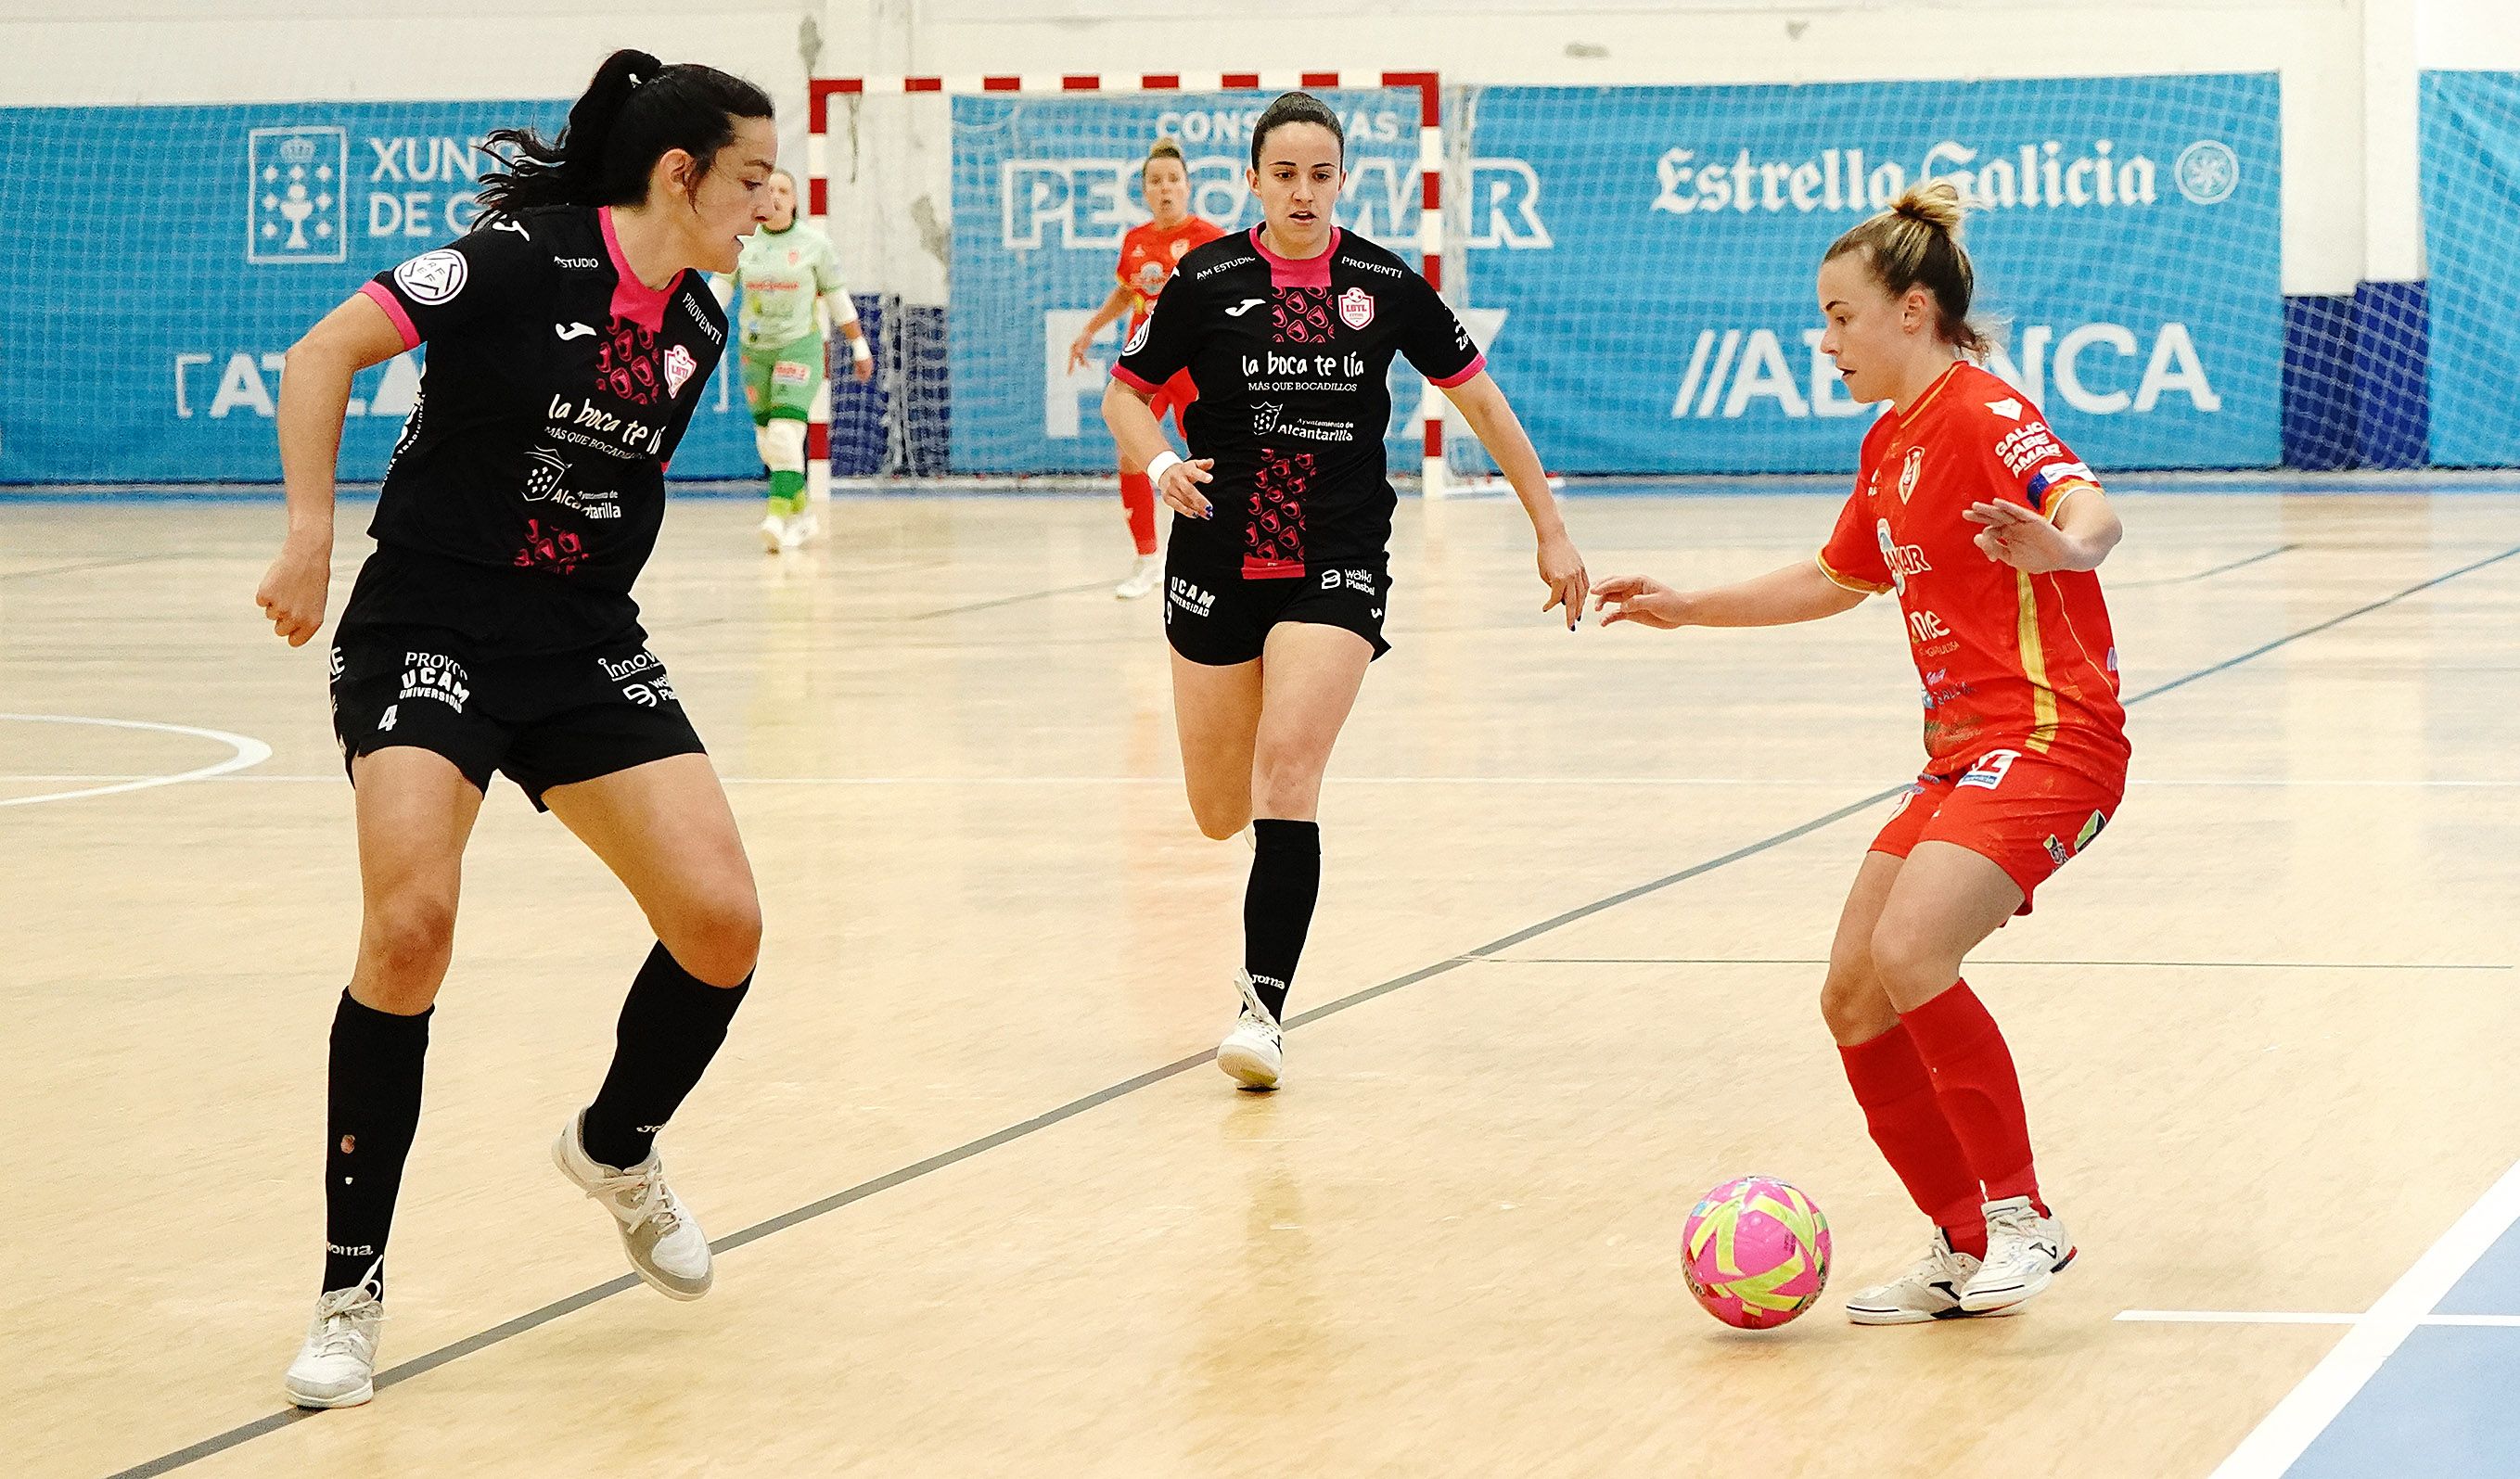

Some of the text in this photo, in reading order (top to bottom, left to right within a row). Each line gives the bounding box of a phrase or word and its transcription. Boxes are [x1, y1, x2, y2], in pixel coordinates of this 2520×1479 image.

[367, 135, 521, 184] XUNT
[1651, 147, 1907, 214] Estrella
[368, 190, 433, 238] DE
[1341, 256, 1402, 279] PROVENTI
[682, 292, 723, 345] PROVENTI
[1242, 355, 1260, 377] la
[1267, 351, 1308, 376] boca
[1314, 354, 1337, 376] te
[1272, 381, 1294, 391] QUE
[1295, 381, 1358, 391] BOCADILLOS
[548, 393, 572, 419] la
[573, 398, 621, 432] boca
[621, 420, 648, 445] te
[1277, 424, 1353, 441] Alcantarilla
[567, 431, 590, 445] QUE
[2003, 432, 2050, 468] SABE
[2012, 443, 2062, 478] AMAR
[1171, 576, 1216, 608] UCAM
[399, 686, 463, 714] UNIVERSIDAD
[402, 667, 470, 704] UCAM
[377, 704, 399, 732] 4
